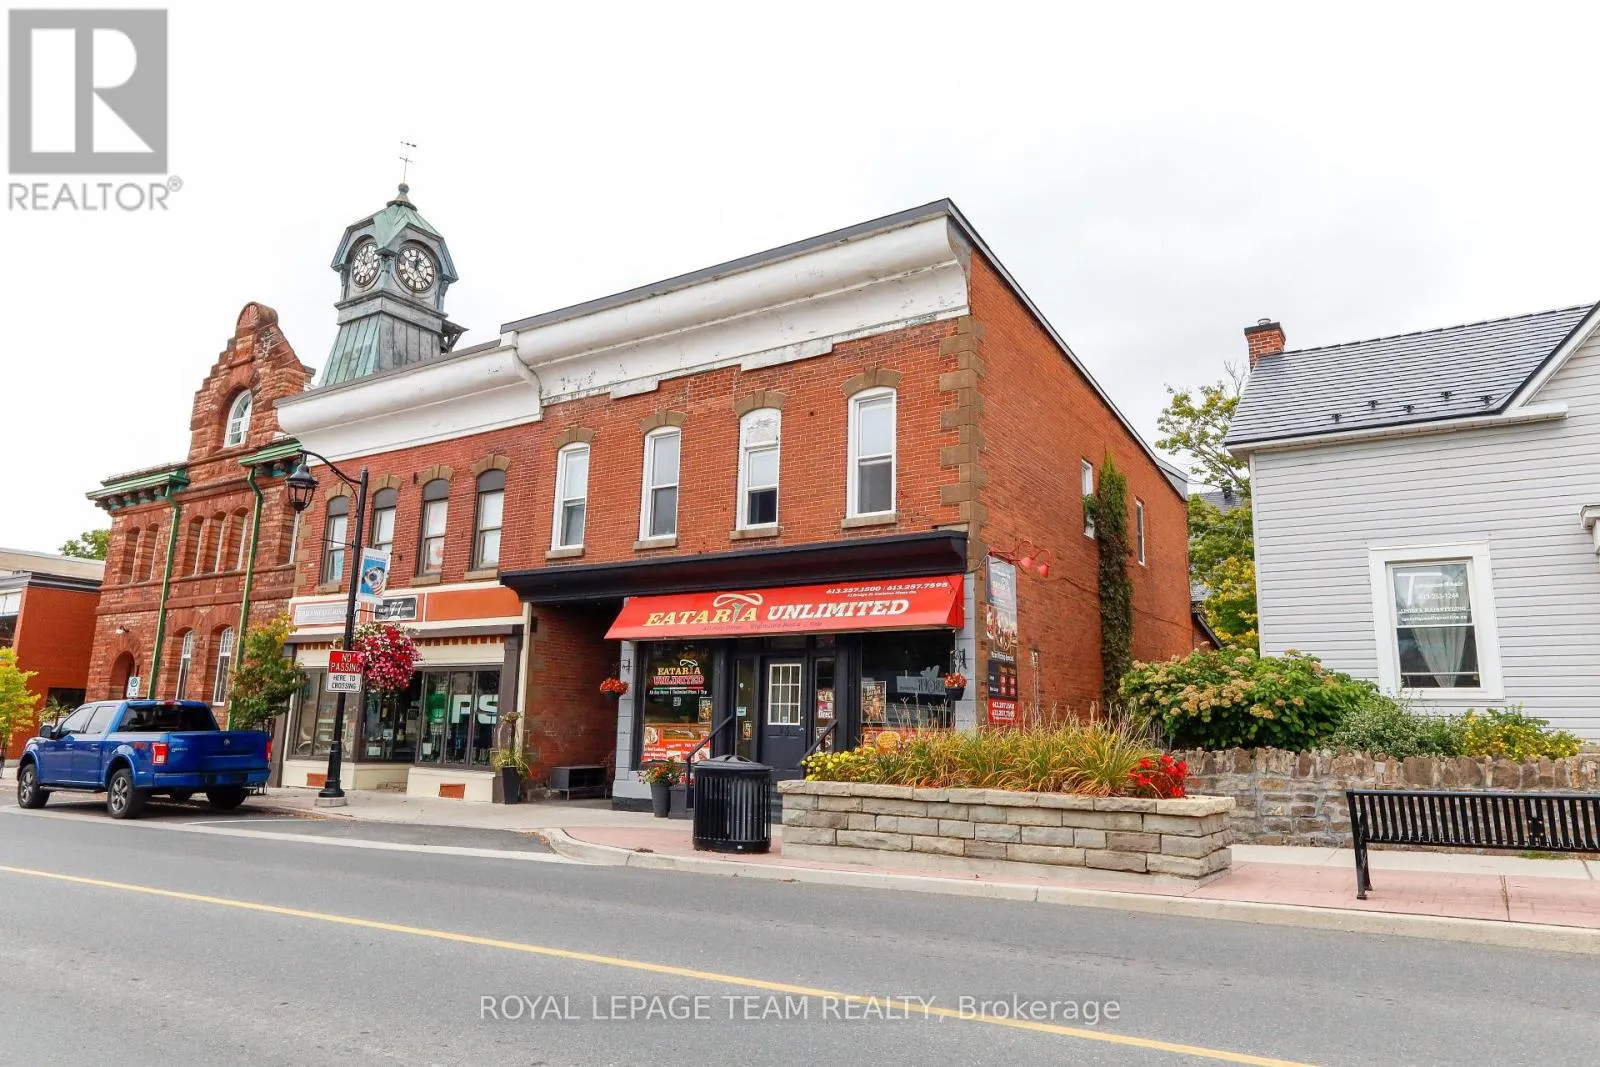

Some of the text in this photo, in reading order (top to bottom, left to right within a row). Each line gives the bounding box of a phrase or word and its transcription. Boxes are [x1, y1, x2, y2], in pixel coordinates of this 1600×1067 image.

[643, 599, 909, 627] EATARIA UNLIMITED
[341, 653, 352, 663] NO
[331, 662, 360, 672] PASSING
